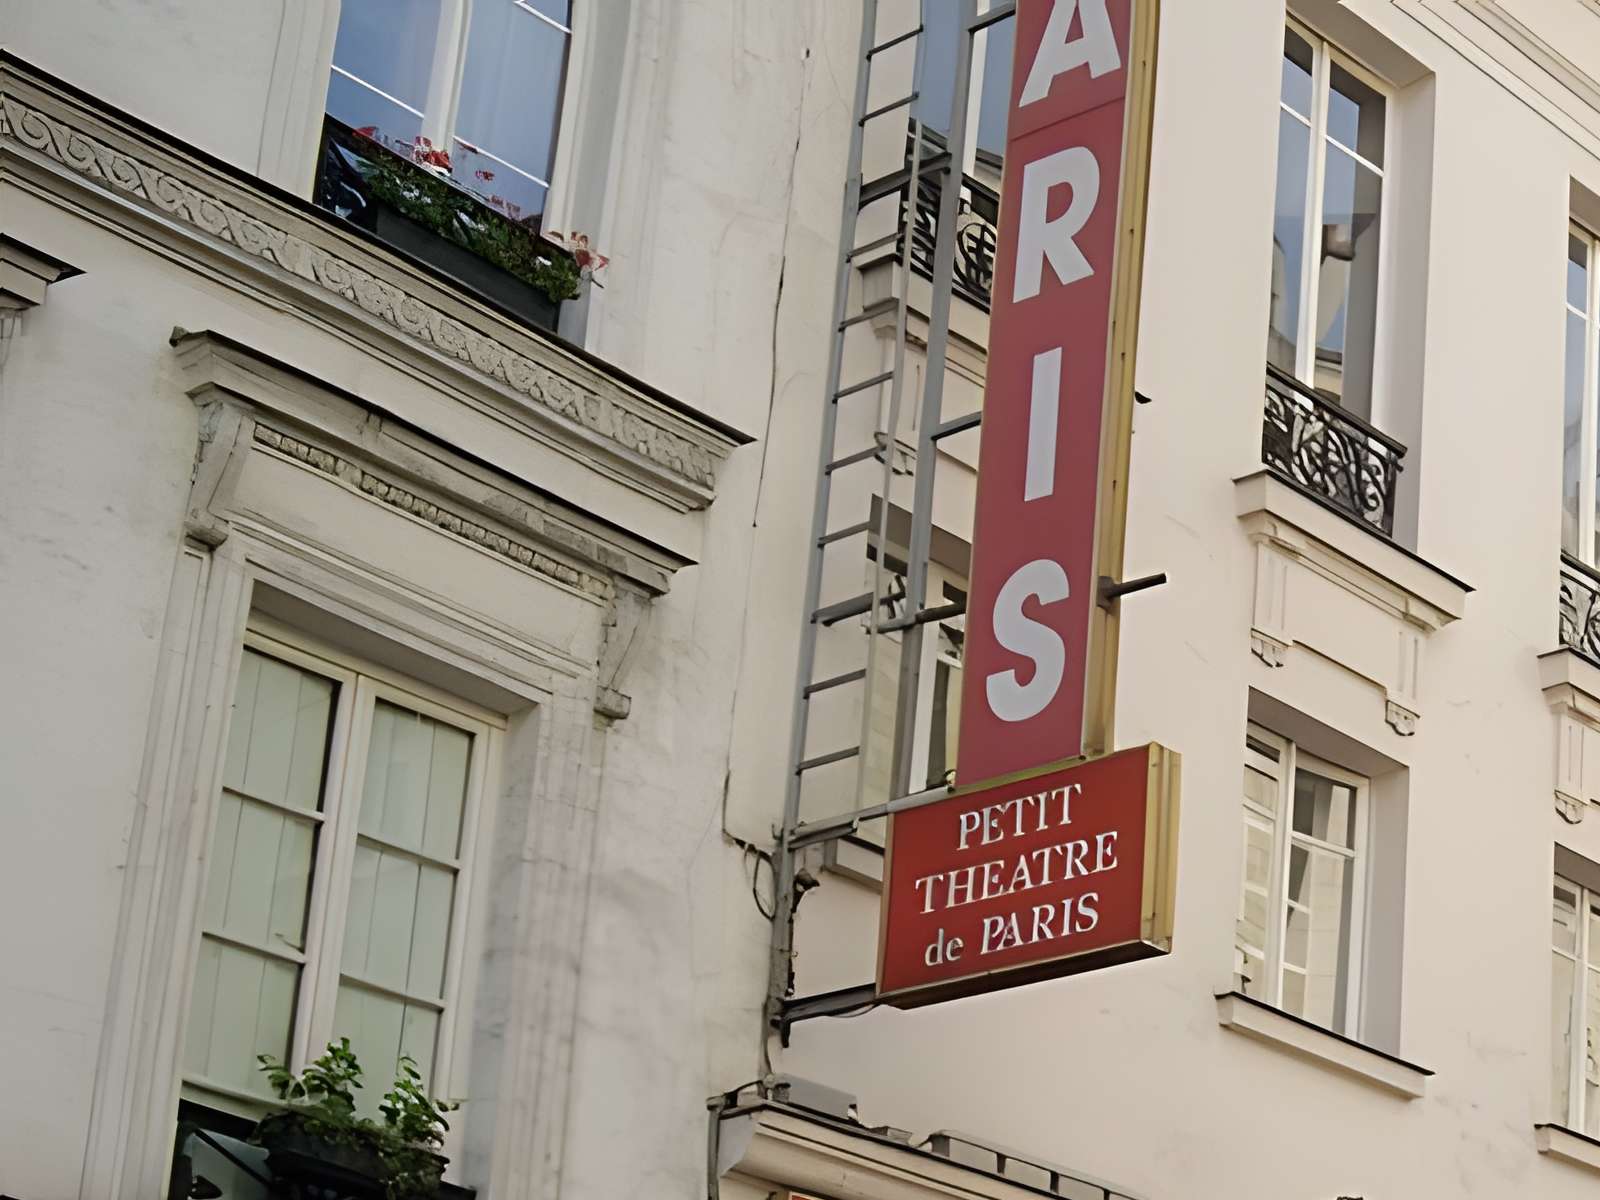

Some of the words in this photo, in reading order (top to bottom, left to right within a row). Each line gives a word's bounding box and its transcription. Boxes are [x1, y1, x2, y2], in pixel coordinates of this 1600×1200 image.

[956, 783, 1082, 851] PETIT
[915, 831, 1119, 914] THEATRE
[924, 928, 964, 967] de
[979, 892, 1100, 955] PARIS
